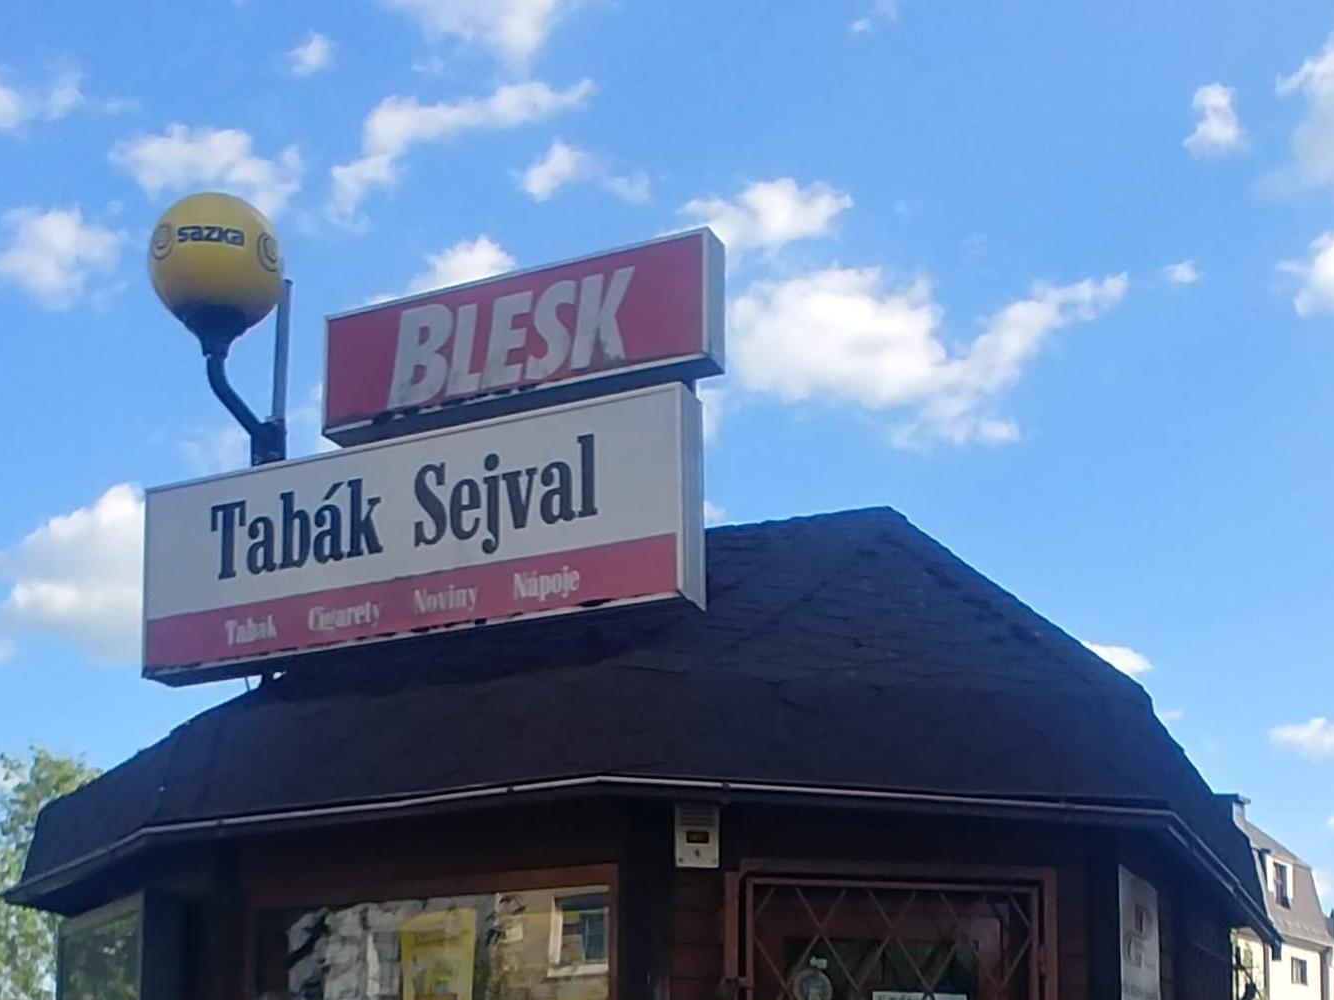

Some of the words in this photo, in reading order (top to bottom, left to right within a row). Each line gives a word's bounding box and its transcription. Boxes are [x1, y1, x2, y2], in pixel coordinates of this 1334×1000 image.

[388, 268, 633, 406] BLESK
[211, 479, 383, 580] Tabák
[413, 434, 597, 553] Sejval
[308, 601, 380, 632] Cigarety
[414, 585, 478, 614] Noviny
[513, 566, 580, 601] Nápoje
